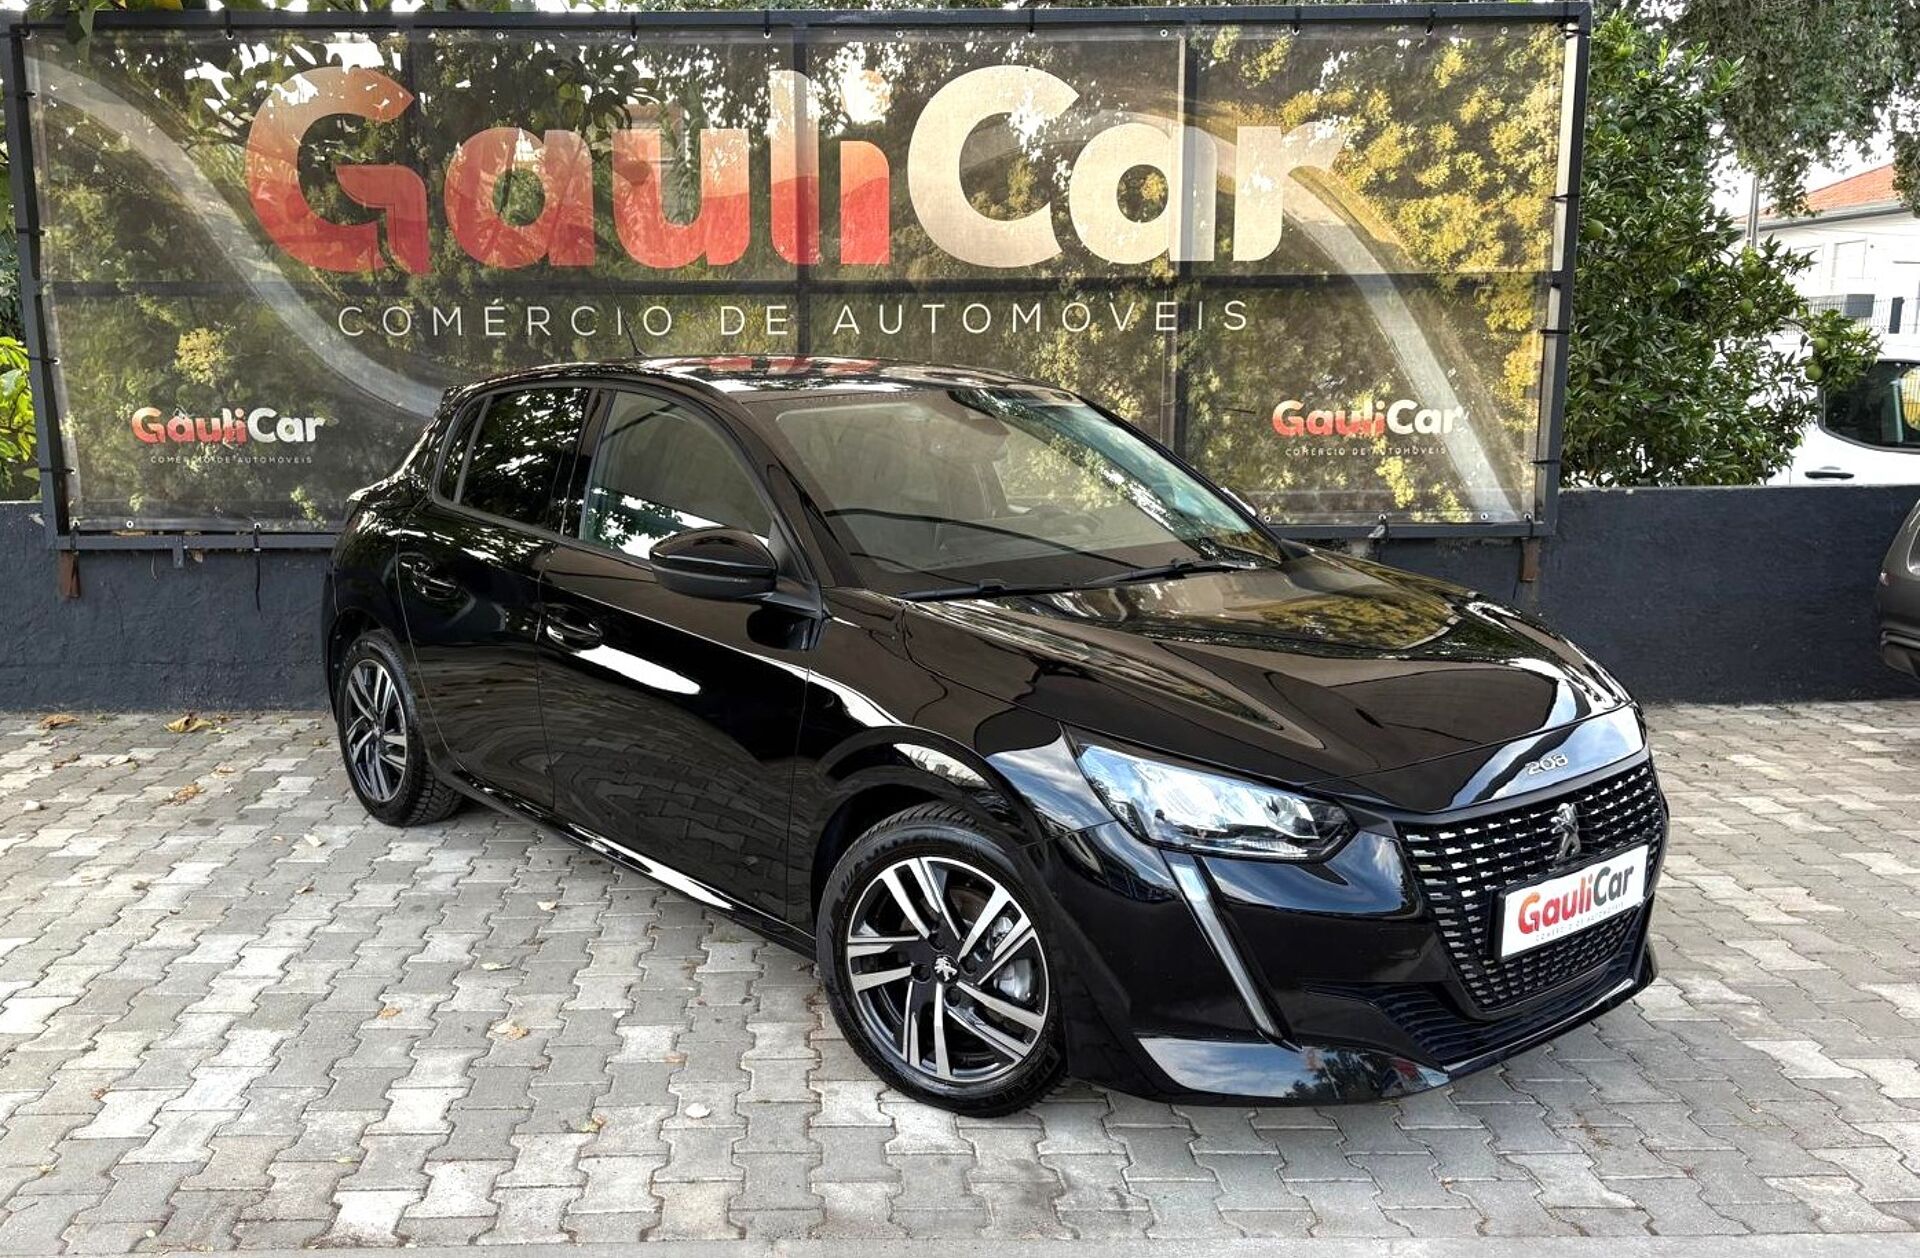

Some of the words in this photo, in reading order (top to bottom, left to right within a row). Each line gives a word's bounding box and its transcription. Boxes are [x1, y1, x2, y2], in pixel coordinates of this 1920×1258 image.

[245, 65, 1347, 275] GauliCar
[338, 297, 672, 336] COMÉRCIO
[720, 305, 788, 335] DE
[131, 407, 326, 444] GauliCar
[1272, 399, 1464, 437] GauliCar
[1525, 753, 1569, 775] 208
[1518, 866, 1635, 934] GauliCar
